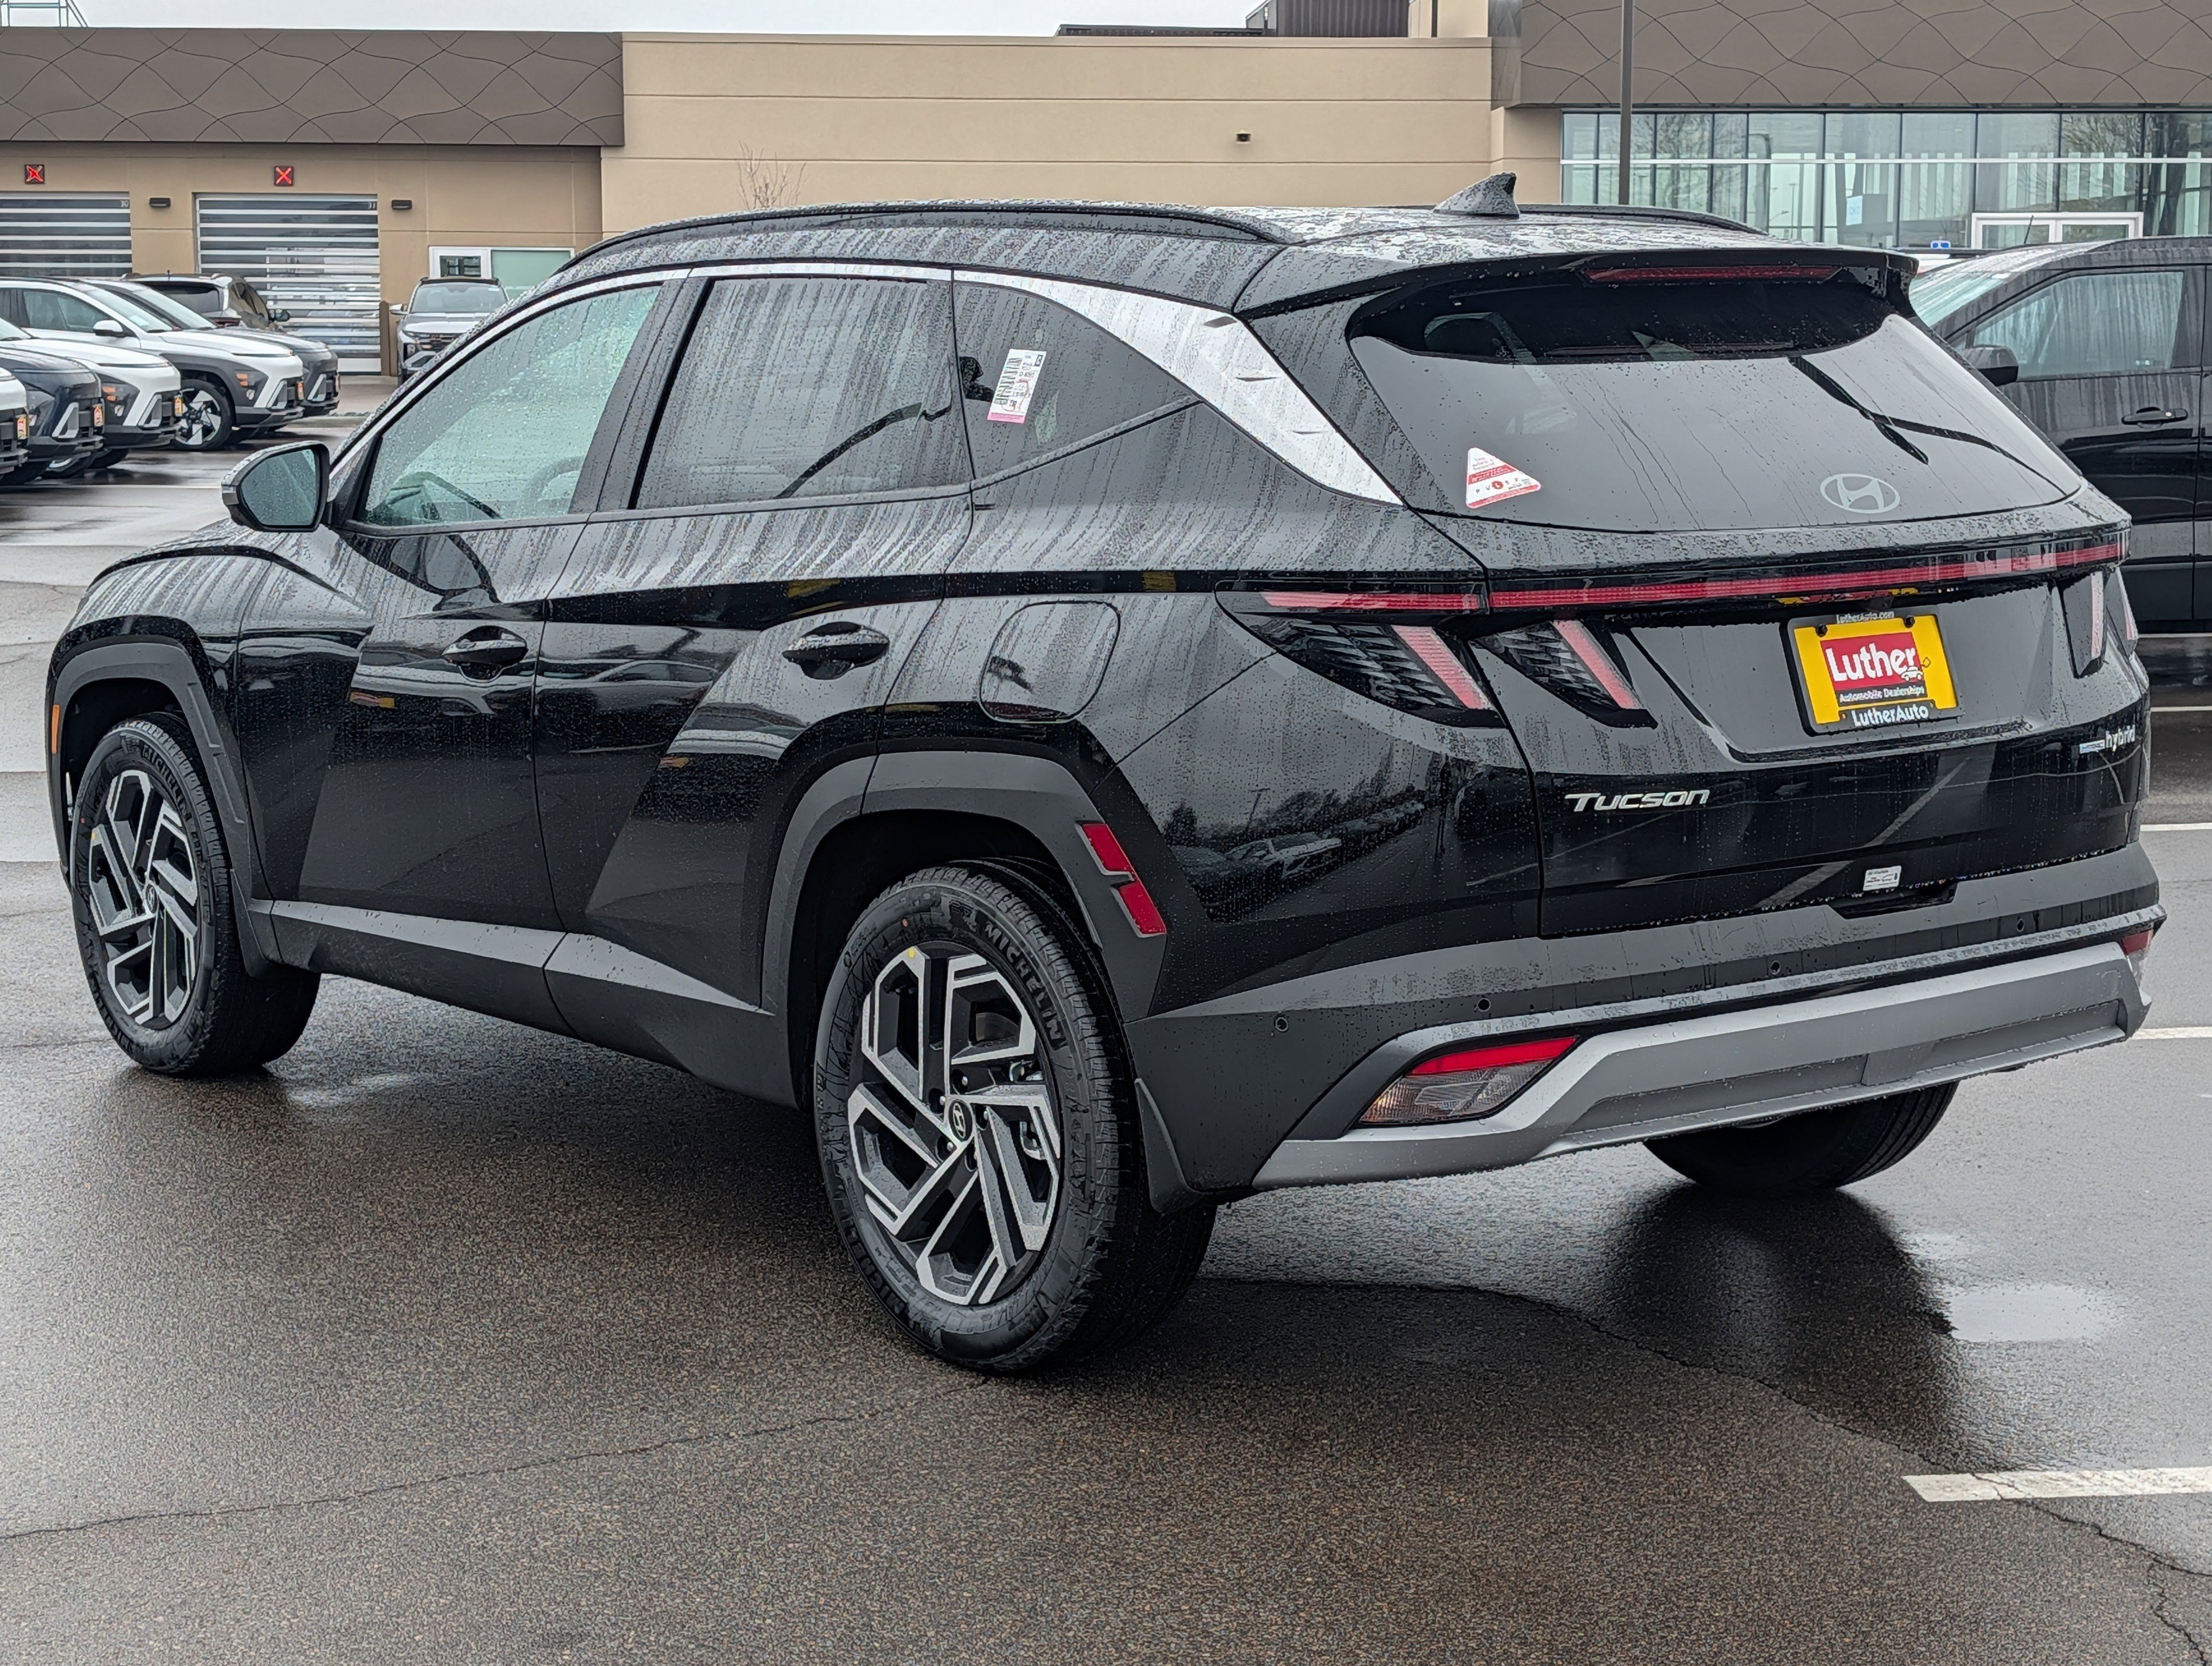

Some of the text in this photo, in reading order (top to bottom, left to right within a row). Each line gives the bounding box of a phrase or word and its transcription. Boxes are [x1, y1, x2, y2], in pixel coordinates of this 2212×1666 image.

[1825, 643, 1916, 682] Luther
[1839, 685, 1924, 702] Automobile Dealerships
[1850, 704, 1928, 727] LutherAuto
[2106, 724, 2136, 752] hybrid
[984, 920, 1062, 1041] MICHELIN
